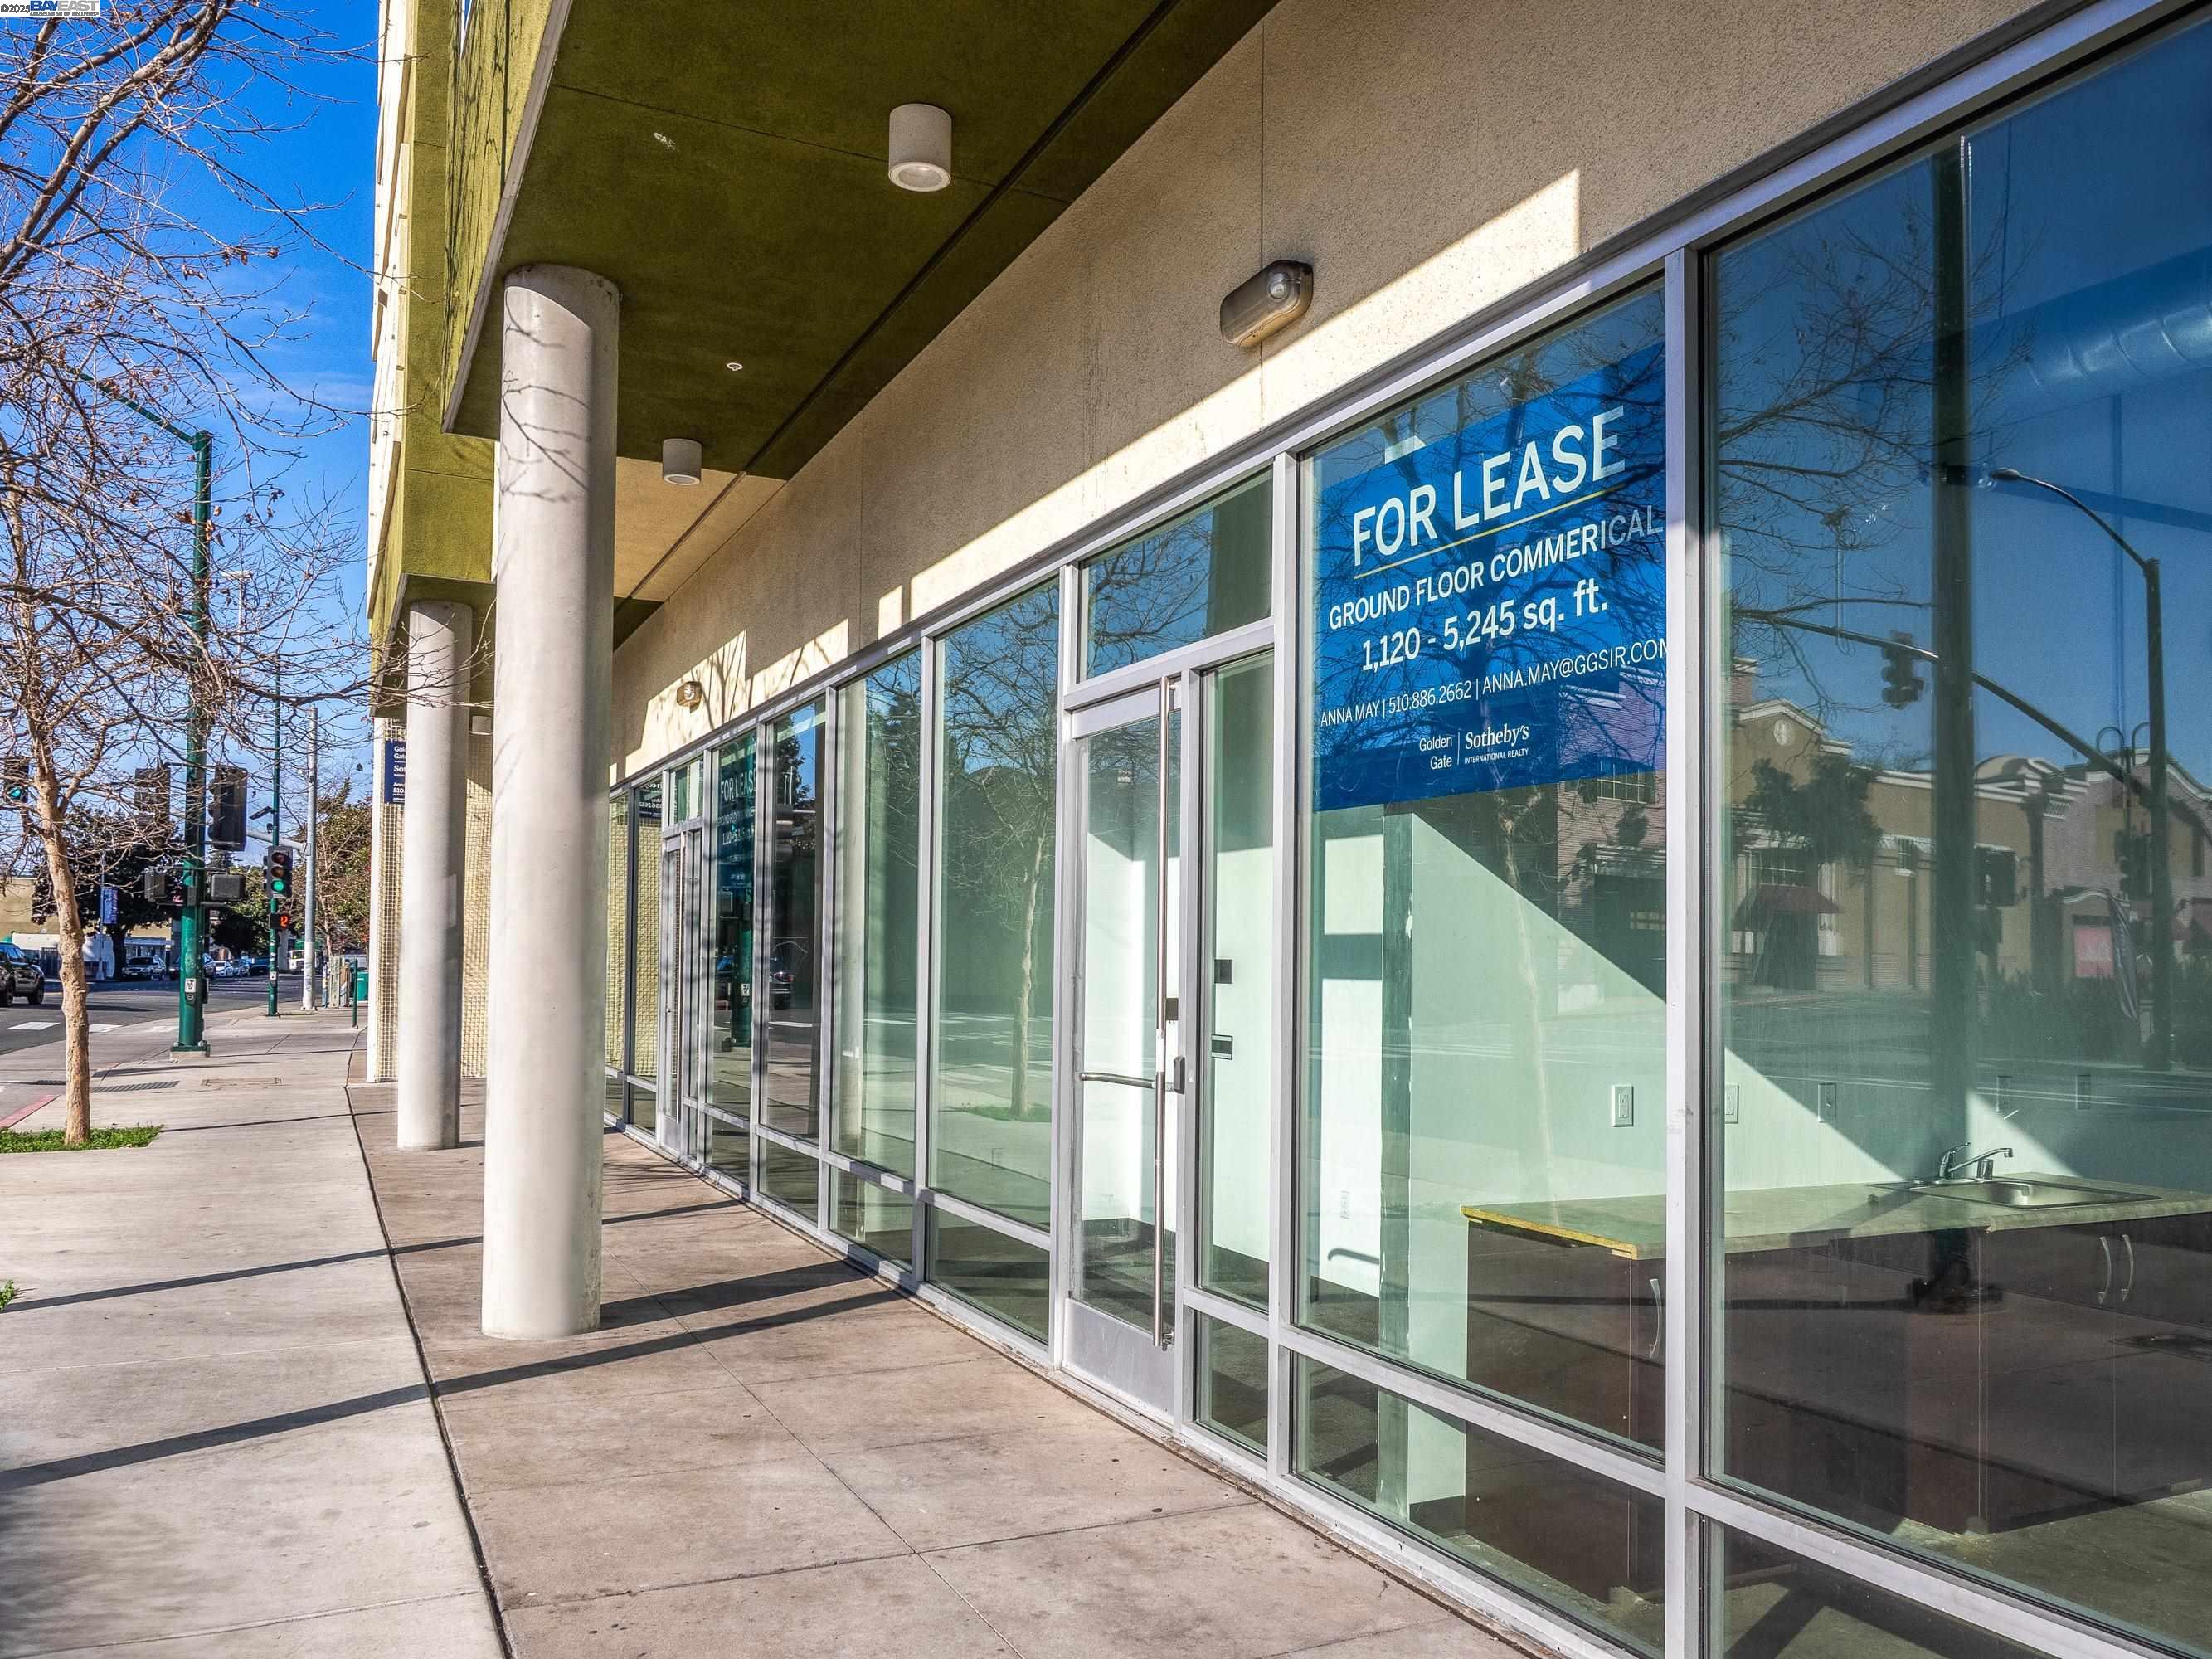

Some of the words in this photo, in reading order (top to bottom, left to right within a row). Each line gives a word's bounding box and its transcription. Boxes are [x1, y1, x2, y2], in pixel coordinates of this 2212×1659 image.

[1354, 484, 1438, 567] FOR
[1454, 406, 1626, 531] LEASE
[1330, 585, 1410, 630] GROUND
[1416, 561, 1485, 606] FLOOR
[1490, 504, 1664, 582] COMMERICAL
[1363, 627, 1420, 673] 1,120
[1443, 599, 1515, 651] 5,245
[1523, 597, 1565, 632] sq.
[1573, 578, 1607, 617] ft.
[1320, 706, 1353, 727] ANNA
[1355, 699, 1380, 720] MAY
[1388, 680, 1472, 713] 510.886.2662
[1419, 735, 1452, 752] Golden
[1465, 723, 1529, 750] Sotheby's
[1430, 755, 1452, 770] Gate
[1464, 750, 1507, 764] INTERNATIONAL
[1507, 747, 1529, 758] REALTY
